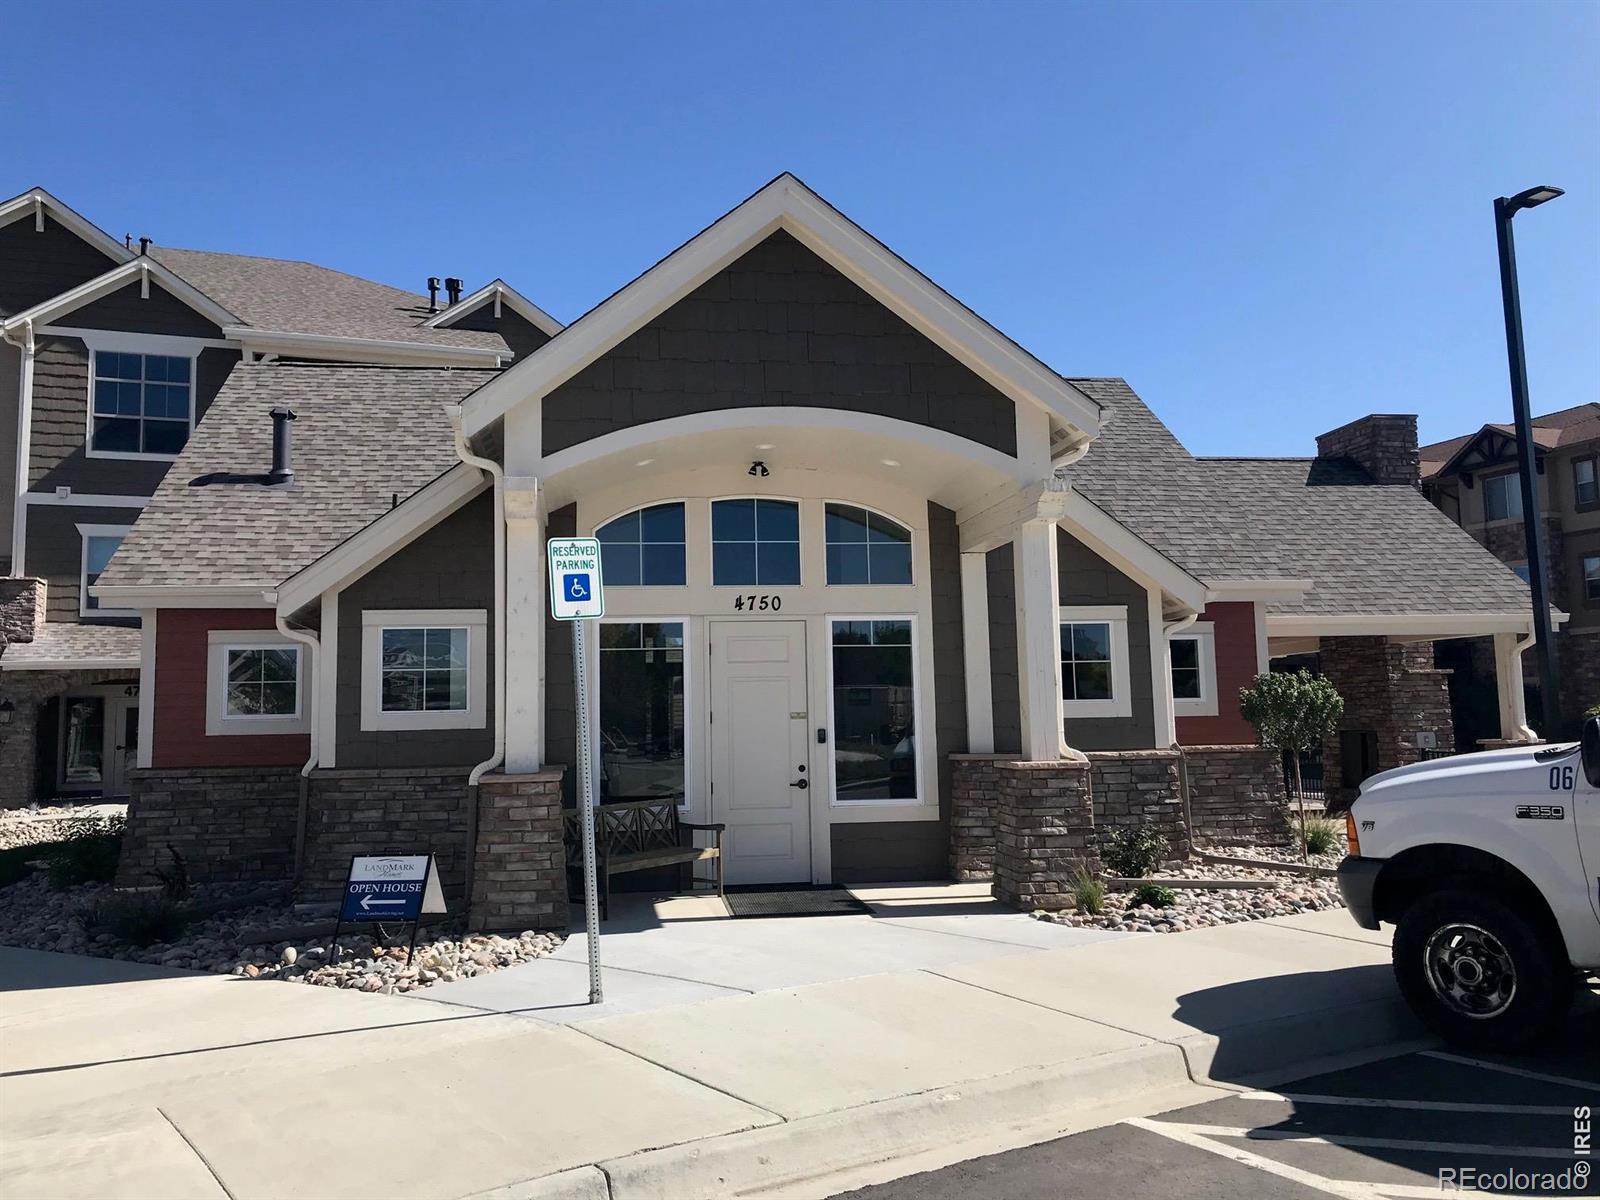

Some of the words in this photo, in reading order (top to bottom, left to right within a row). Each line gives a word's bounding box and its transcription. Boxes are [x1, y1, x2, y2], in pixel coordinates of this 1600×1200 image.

[552, 546, 596, 557] RESERVED
[556, 560, 595, 570] PARKING
[734, 595, 782, 611] 4750
[1550, 766, 1573, 790] 06
[364, 863, 415, 872] LANDMARK
[350, 883, 380, 893] OPEN
[382, 883, 422, 893] HOUSE
